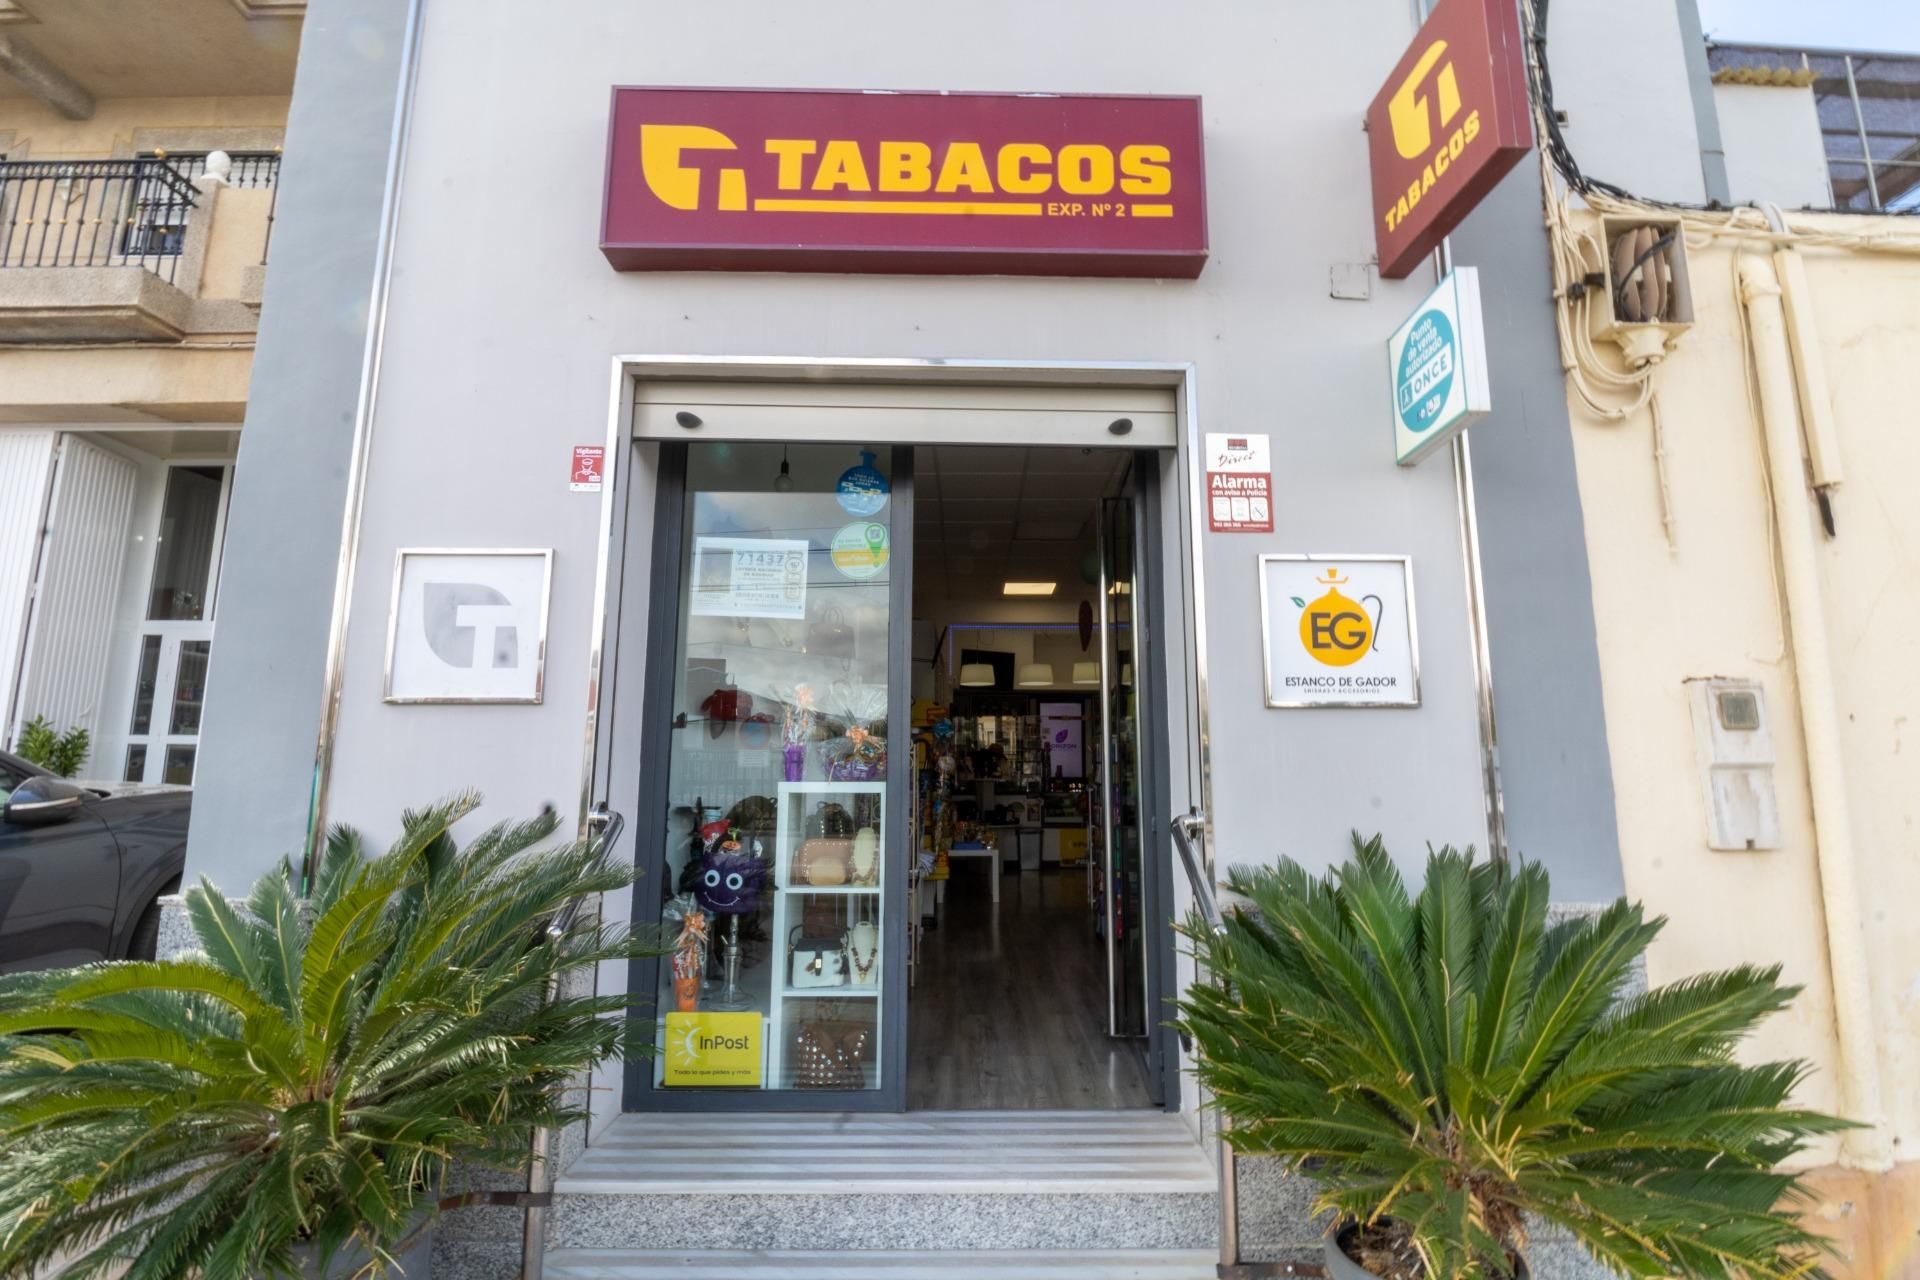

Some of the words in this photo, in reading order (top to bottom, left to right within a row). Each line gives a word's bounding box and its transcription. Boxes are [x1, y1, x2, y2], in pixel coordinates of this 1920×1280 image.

[765, 138, 1173, 196] TABACOS
[1384, 108, 1480, 233] TABACOS
[1047, 203, 1086, 217] EXP.
[1114, 204, 1126, 217] 2
[1410, 317, 1432, 345] Punto
[1417, 326, 1438, 351] venta
[1405, 335, 1443, 378] autorizado
[1414, 353, 1448, 394] ONCE
[1212, 474, 1267, 488] Alarma
[1310, 612, 1367, 650] EG
[1285, 676, 1336, 687] ESTANCO
[1338, 676, 1353, 687] DE
[1355, 677, 1397, 687] GADOR
[699, 1035, 750, 1050] InPost
